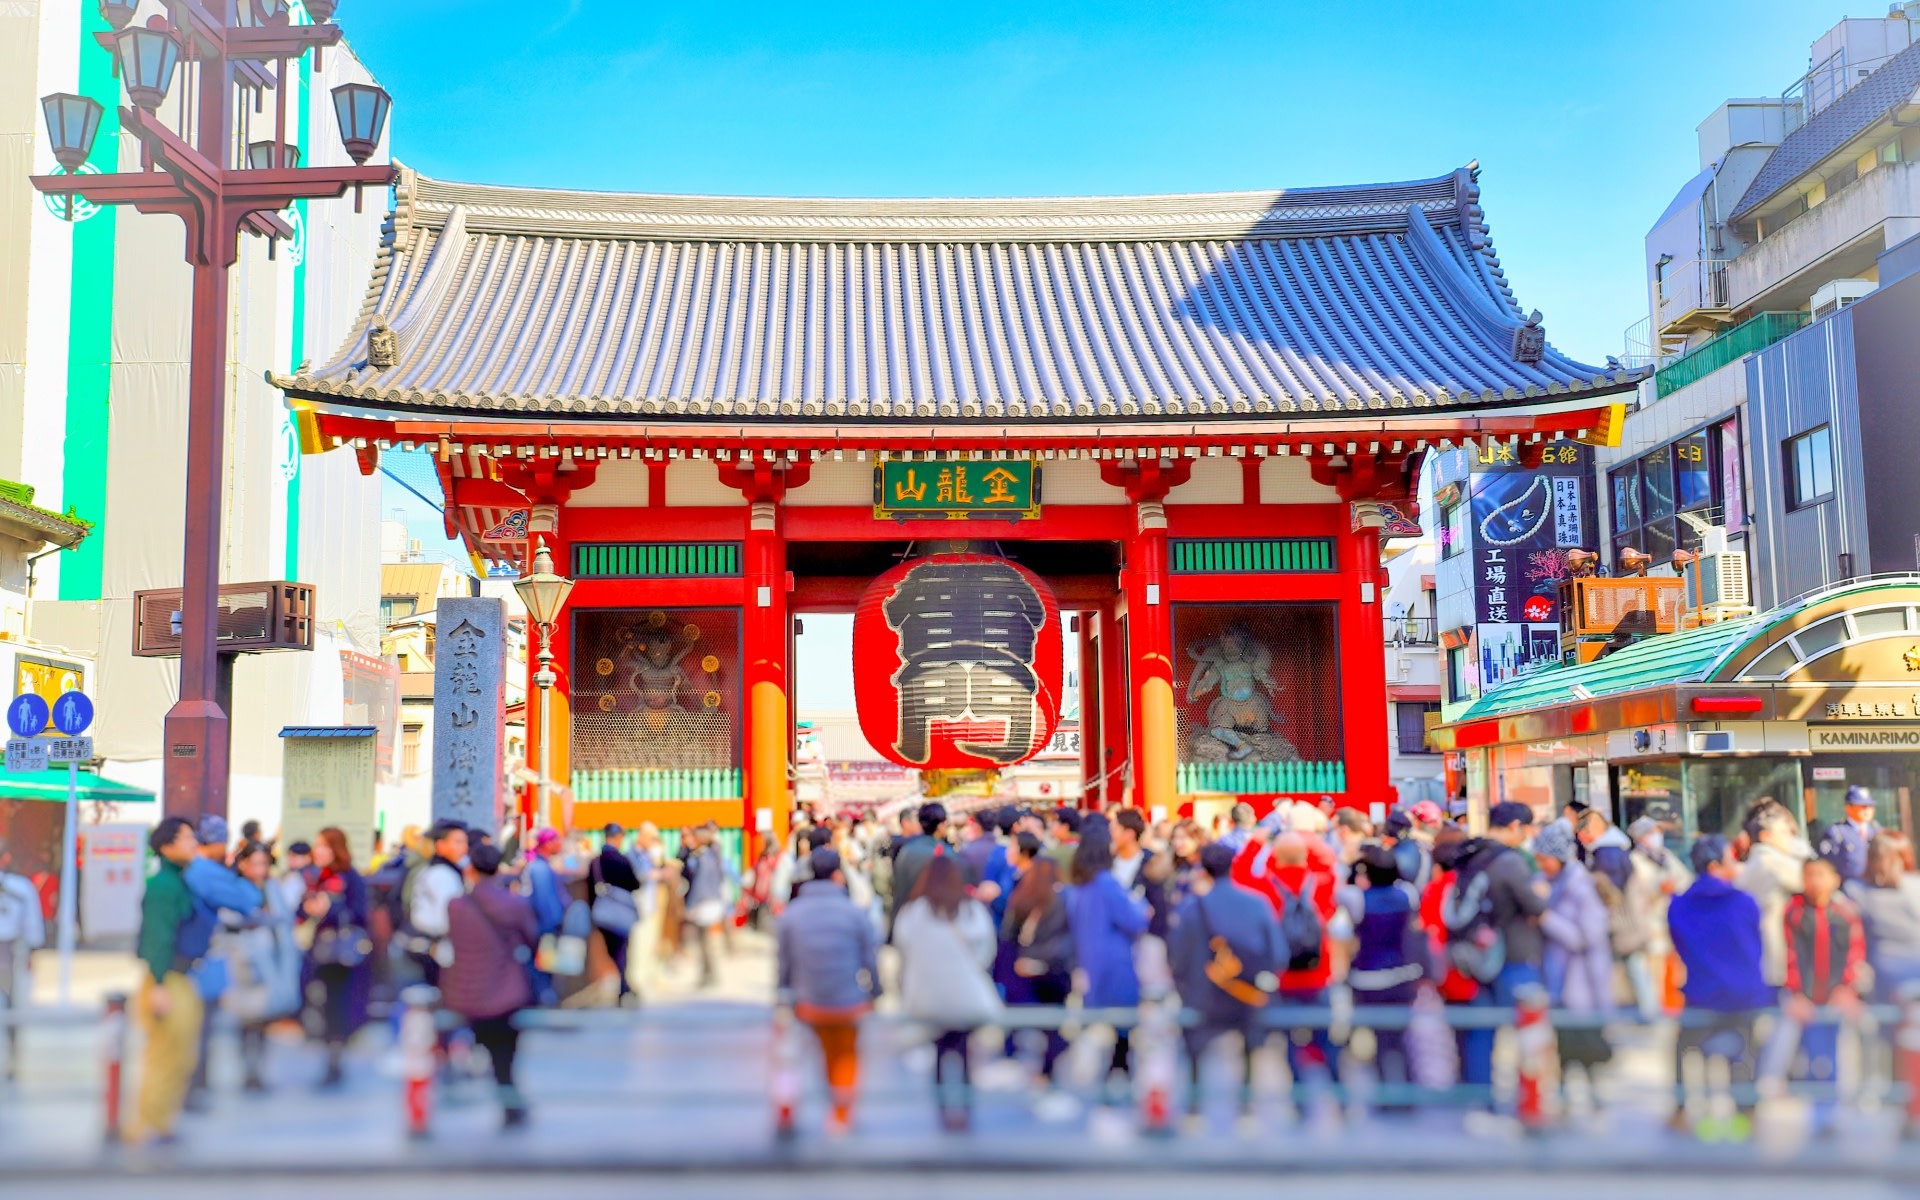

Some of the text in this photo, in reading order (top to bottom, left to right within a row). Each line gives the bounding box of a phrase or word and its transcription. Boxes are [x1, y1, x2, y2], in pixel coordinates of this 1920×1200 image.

[896, 465, 1020, 504] 金龍山
[1556, 481, 1568, 544] 日本真珠
[1567, 480, 1579, 544] 日本血赤珊瑚
[1484, 549, 1510, 623] 工場直送
[882, 562, 1046, 764] 雷門
[1820, 732, 1920, 745] KAMINARIMO
